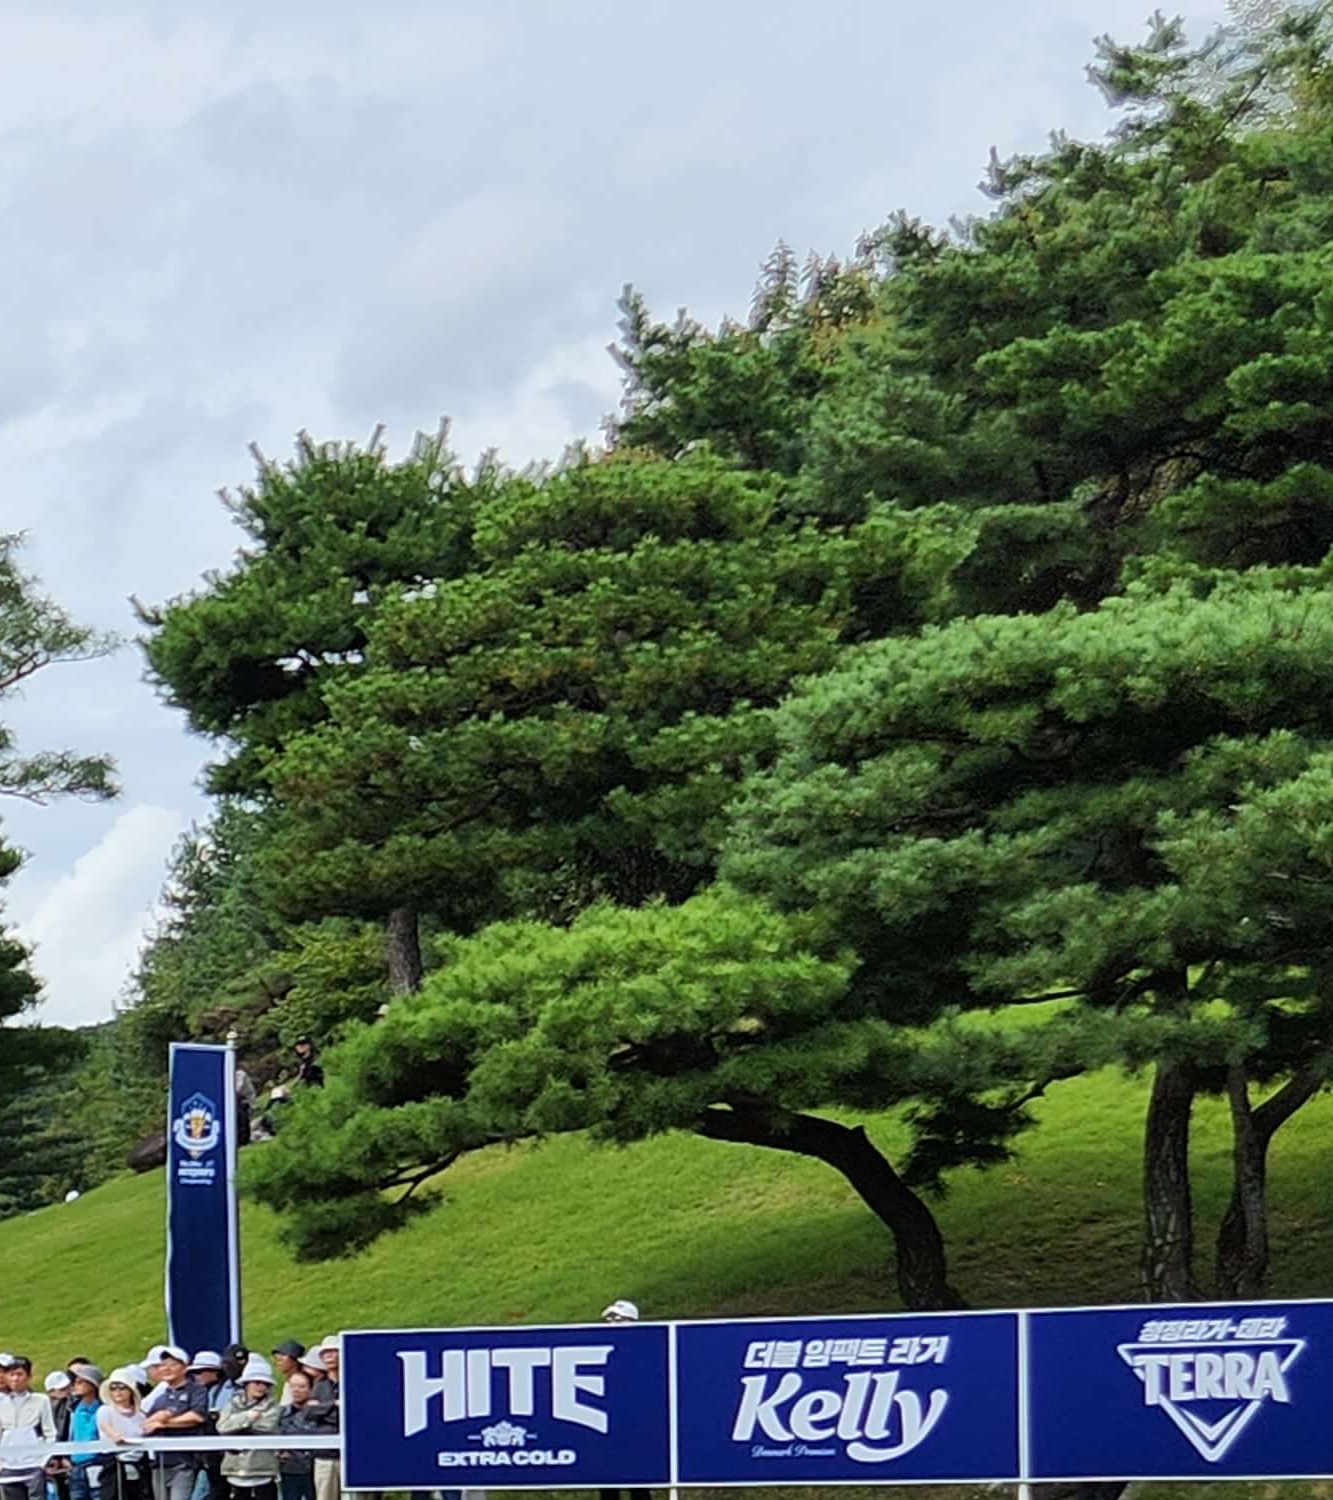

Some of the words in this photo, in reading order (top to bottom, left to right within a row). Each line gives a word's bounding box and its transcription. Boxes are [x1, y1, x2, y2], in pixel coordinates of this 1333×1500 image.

[742, 1339, 803, 1369] 더블
[801, 1337, 889, 1368] 임팩트
[887, 1334, 950, 1365] 라거
[1132, 1350, 1290, 1406] TERRA
[395, 1345, 615, 1438] HITE
[731, 1369, 950, 1464] Kelly
[437, 1451, 512, 1467] EXTRA
[512, 1449, 577, 1466] COLD
